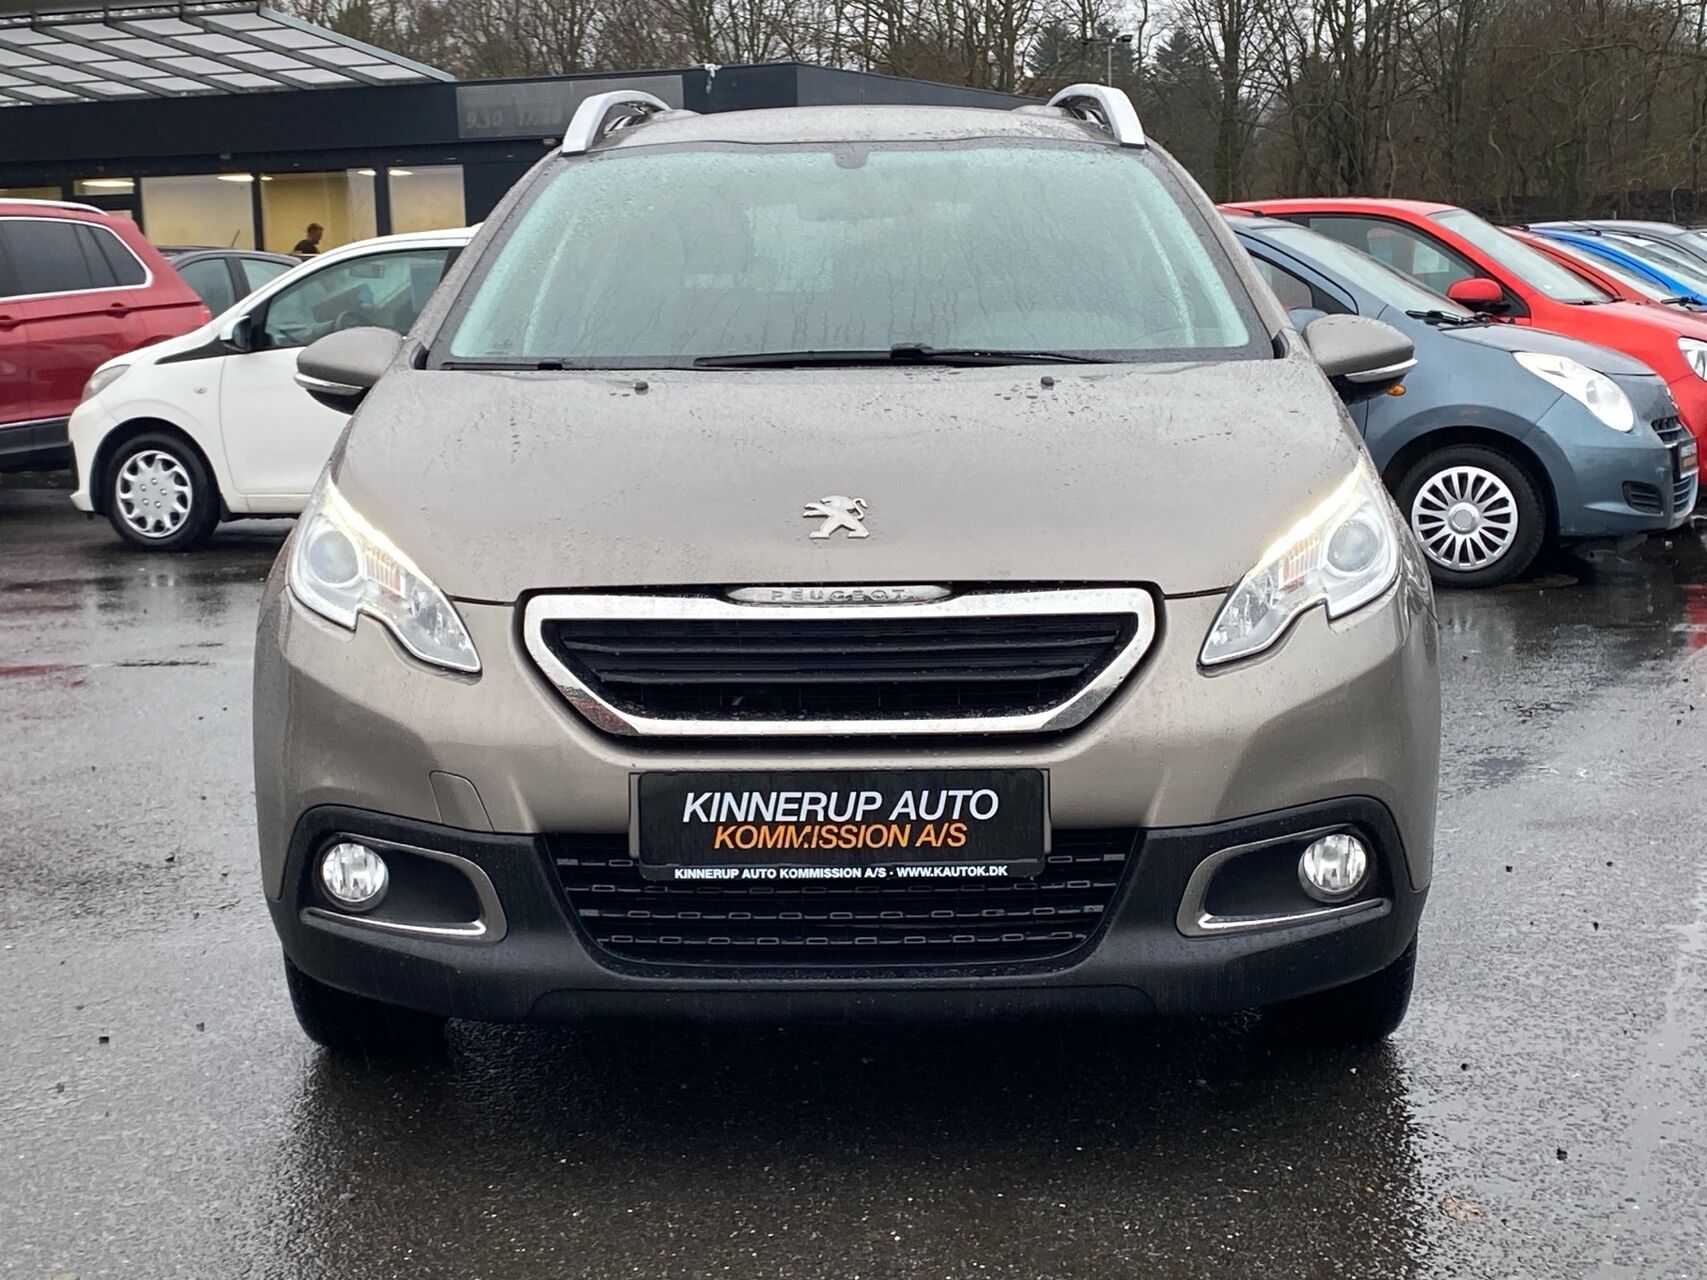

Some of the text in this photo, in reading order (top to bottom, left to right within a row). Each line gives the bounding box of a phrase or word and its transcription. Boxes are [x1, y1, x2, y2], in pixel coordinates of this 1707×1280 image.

[771, 589, 905, 601] PEUGEOT
[682, 788, 999, 823] KINNERUP AUTO
[714, 823, 967, 849] KOMMISSION A/S
[674, 868, 739, 879] KINNERUP
[742, 868, 777, 879] AUTO
[779, 867, 862, 879] KOMMISSION
[864, 867, 887, 878] A/S
[896, 865, 1008, 878] WWW.KAUTOK.DK
